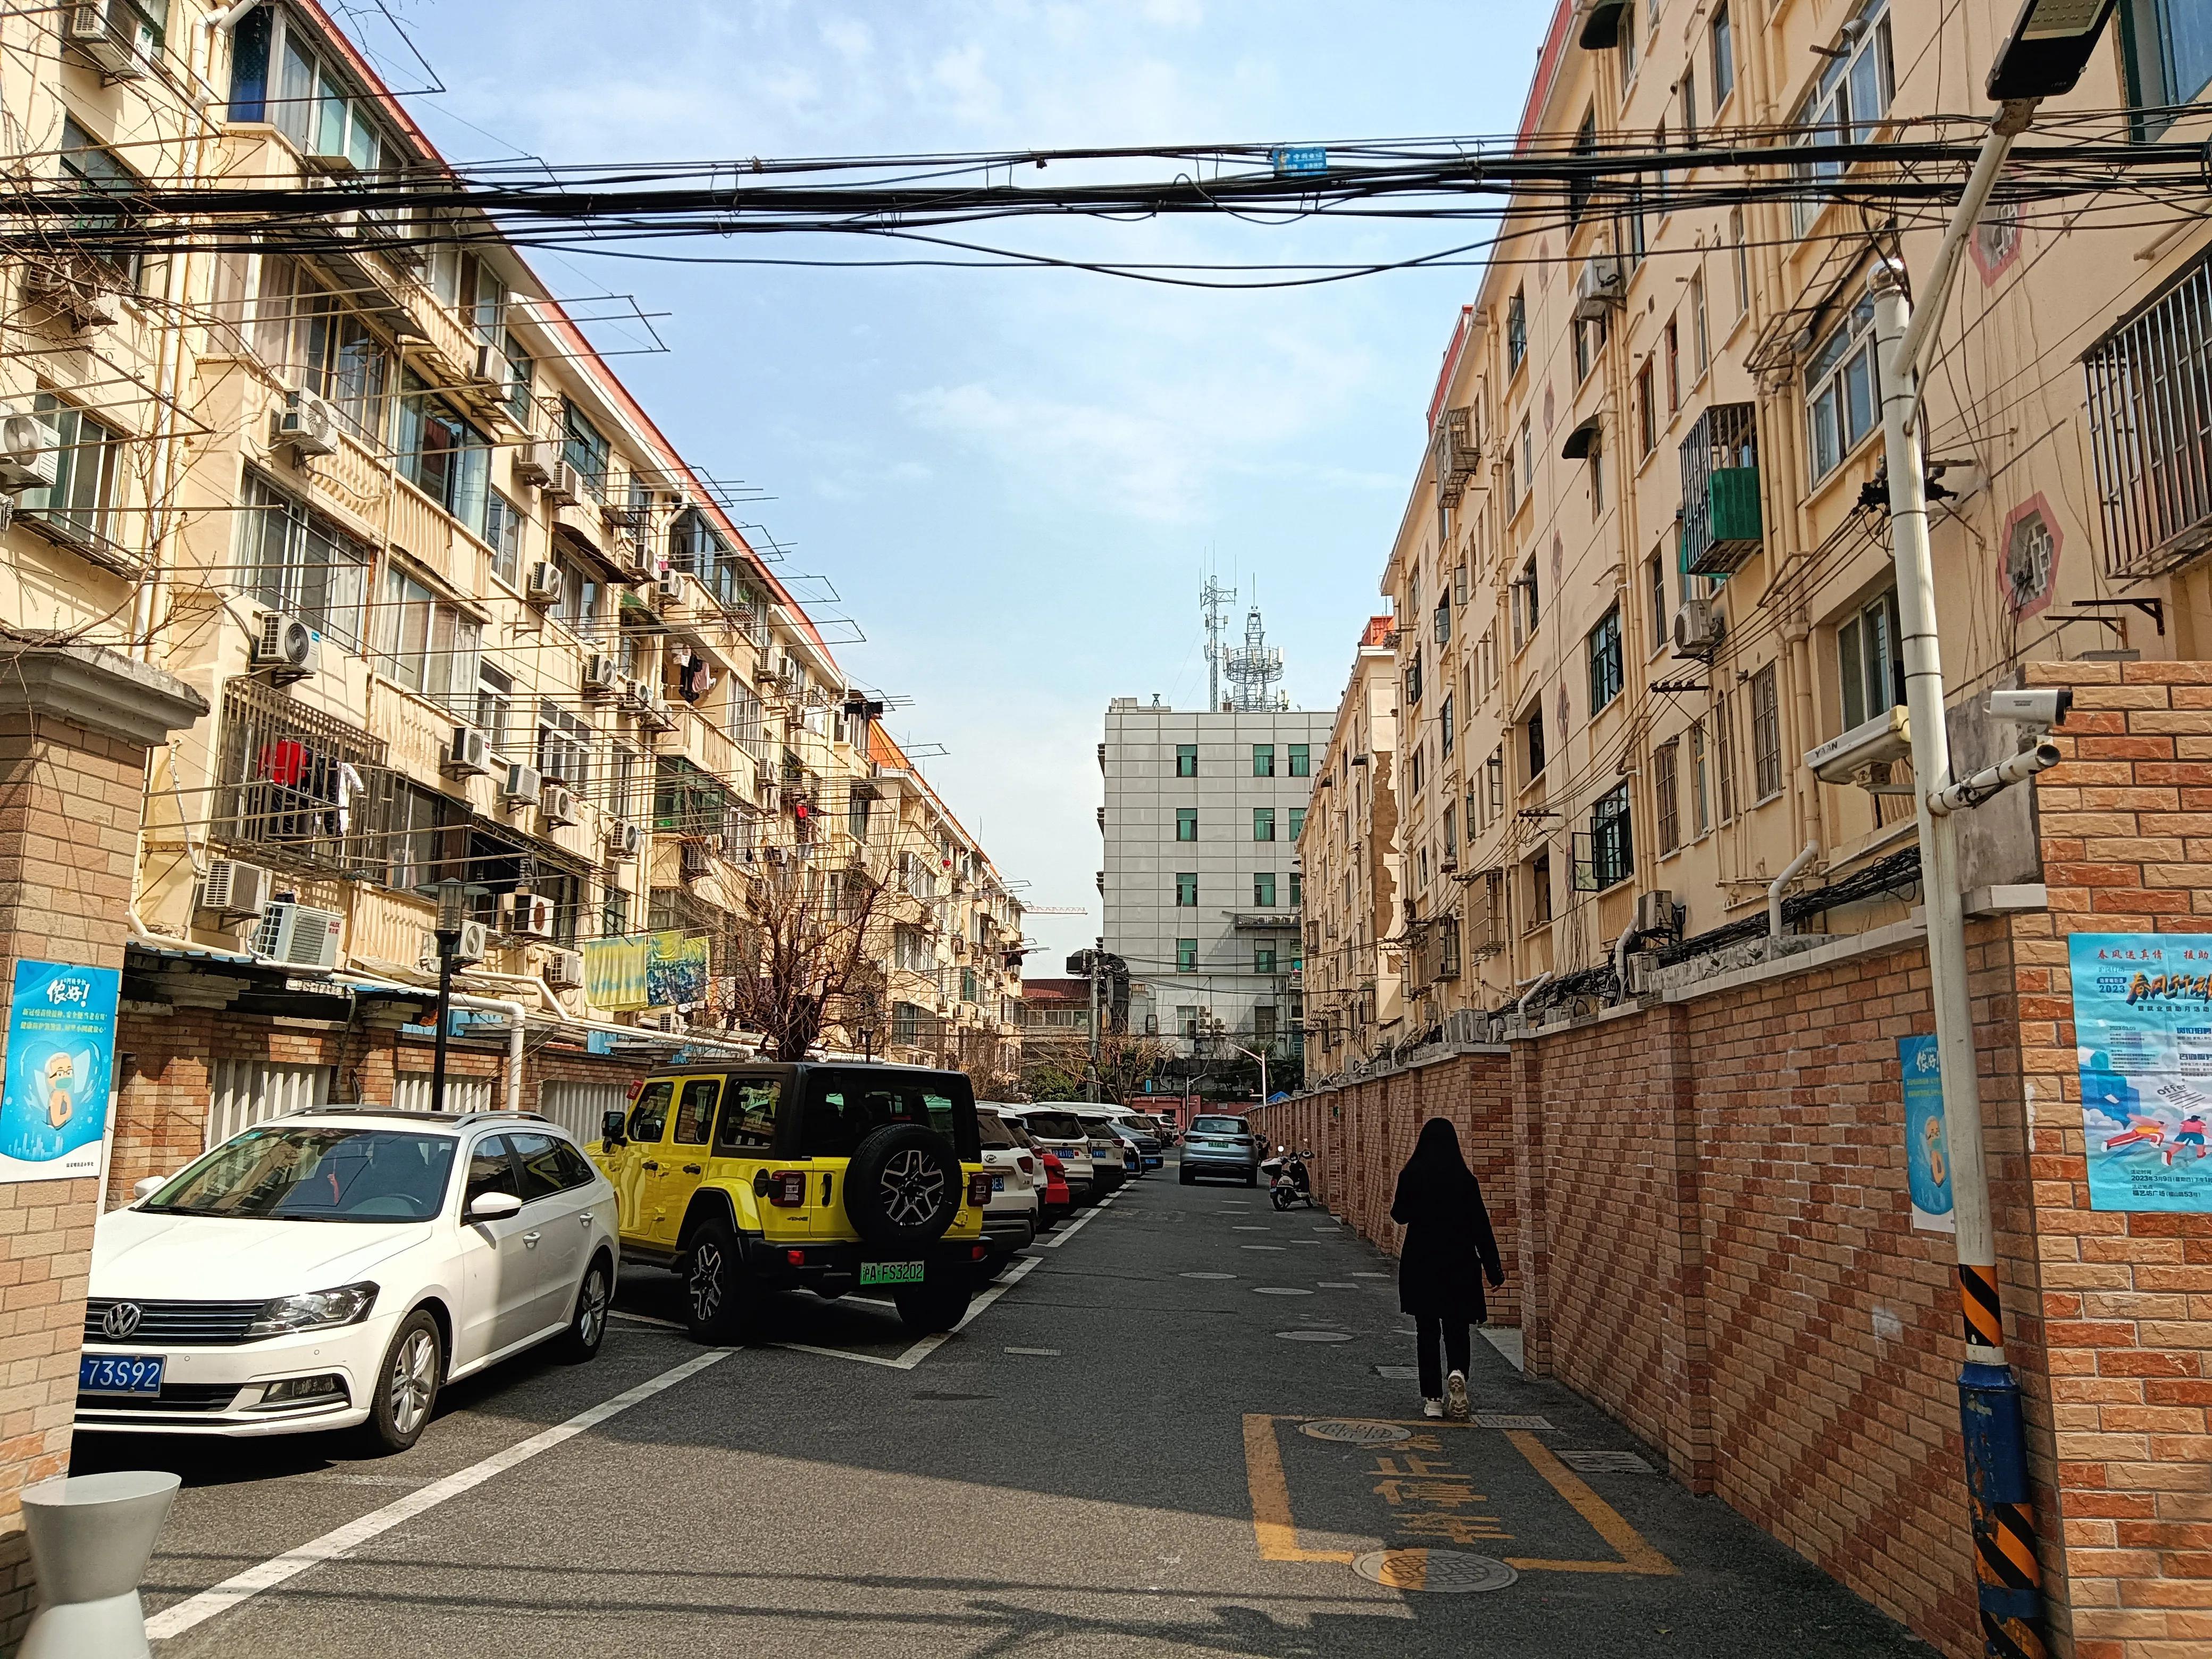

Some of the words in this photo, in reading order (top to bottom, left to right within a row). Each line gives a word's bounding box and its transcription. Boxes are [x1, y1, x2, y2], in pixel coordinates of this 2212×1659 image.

[2098, 949, 2163, 960] 春风送真情
[2184, 950, 2209, 960] 援助
[2099, 985, 2125, 993] 2023
